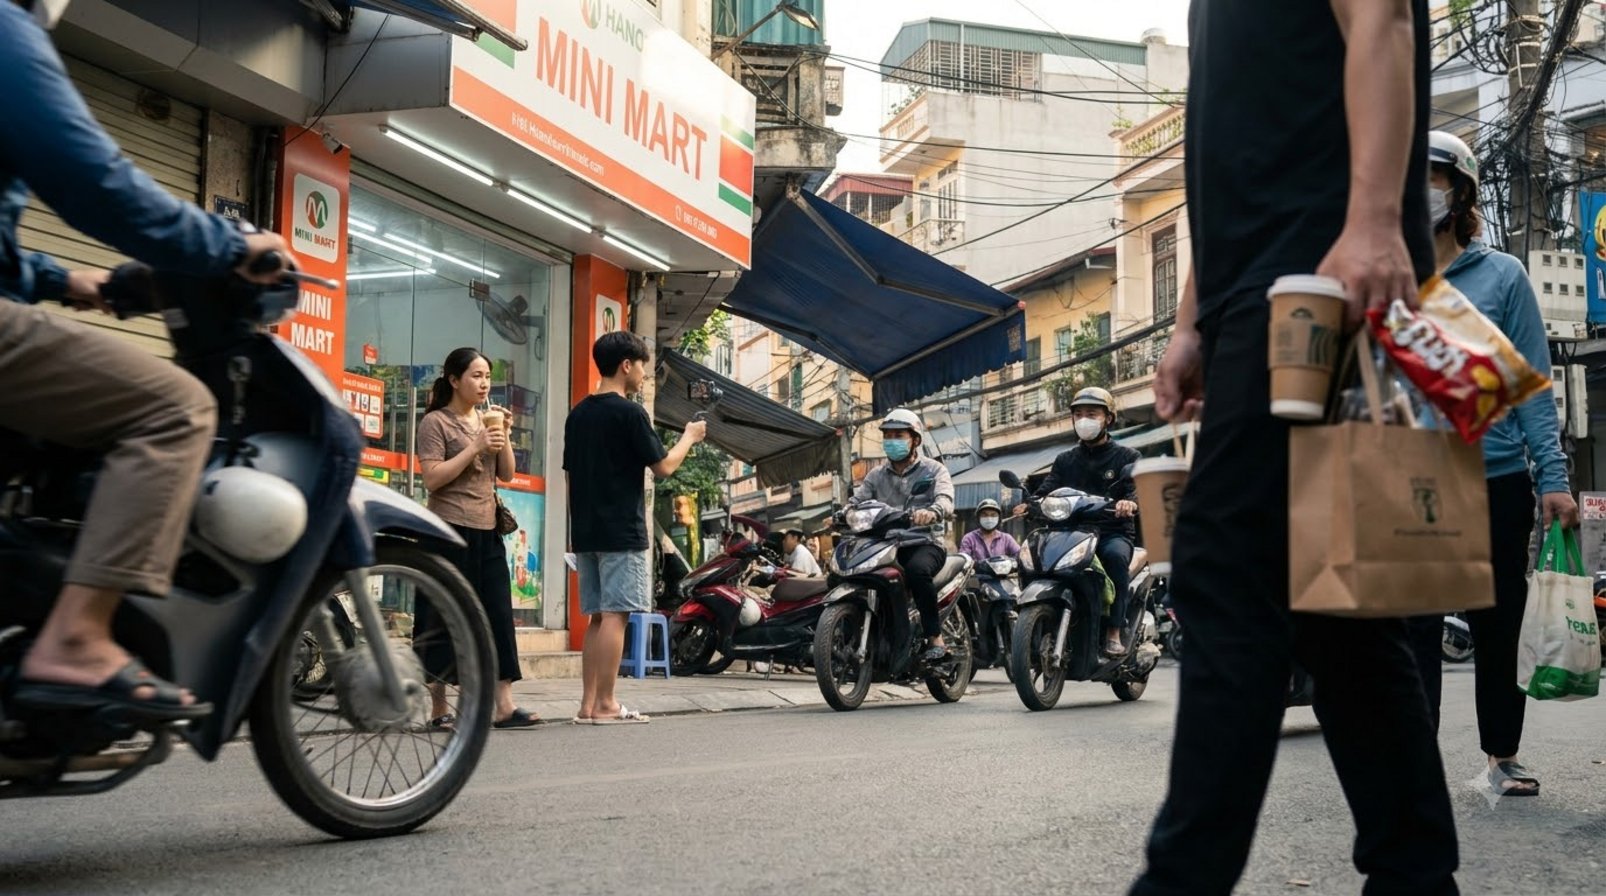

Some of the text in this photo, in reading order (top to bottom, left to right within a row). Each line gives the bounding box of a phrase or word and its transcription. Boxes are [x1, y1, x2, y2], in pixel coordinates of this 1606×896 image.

[536, 16, 613, 125] MINI
[624, 78, 708, 181] MART
[295, 227, 336, 250] MINI MART
[297, 289, 332, 320] MINI
[291, 321, 335, 356] MART
